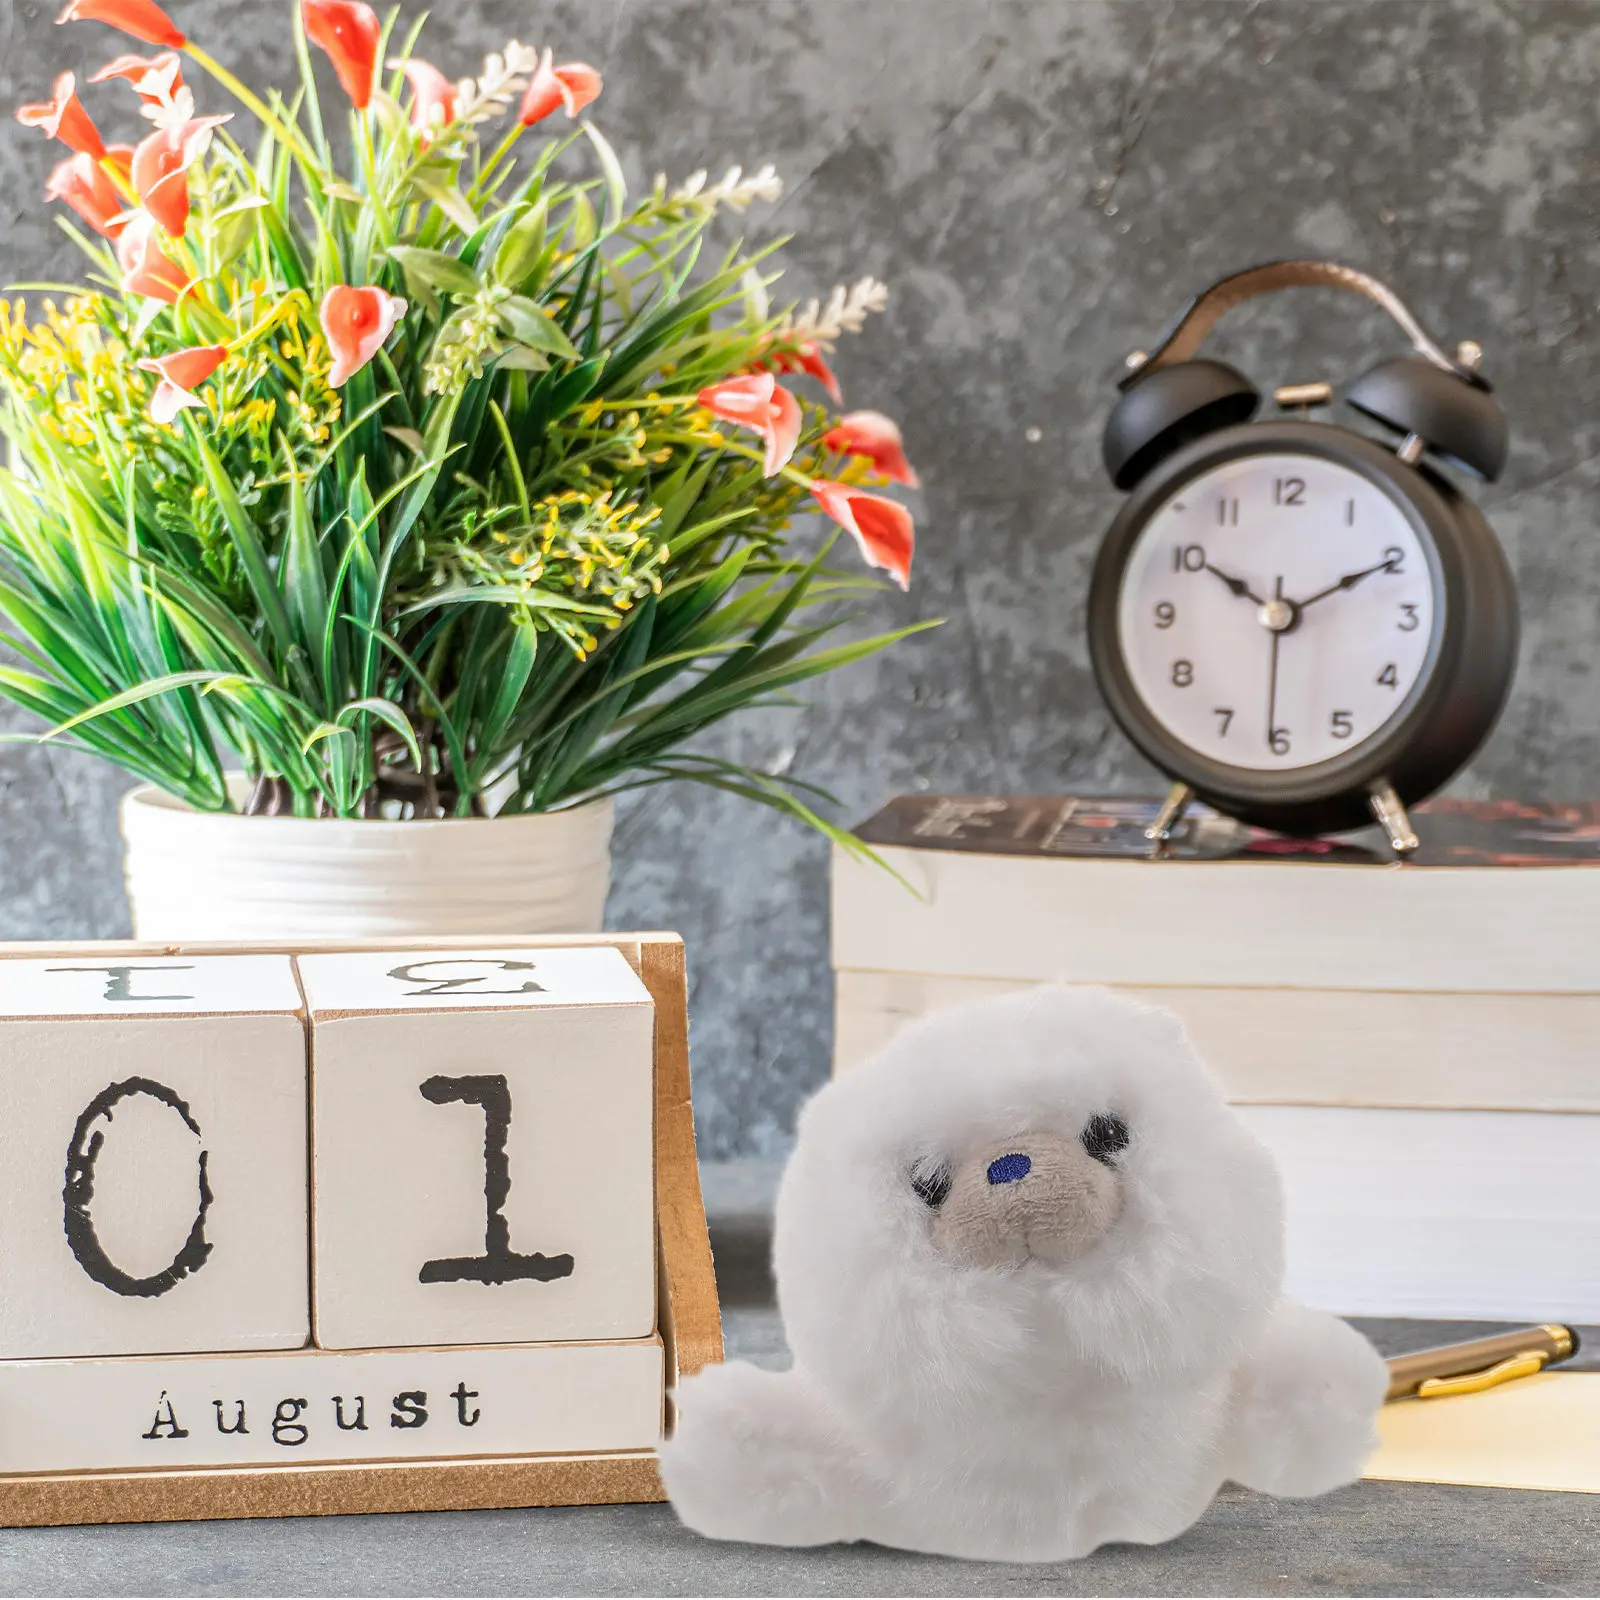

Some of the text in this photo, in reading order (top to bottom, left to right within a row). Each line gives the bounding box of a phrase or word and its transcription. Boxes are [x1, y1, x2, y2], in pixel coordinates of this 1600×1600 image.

[1275, 477, 1306, 506] 12
[1218, 497, 1239, 526] 11
[1346, 499, 1354, 527] 1
[1173, 543, 1206, 574] 10
[1382, 547, 1405, 575] 2
[1154, 602, 1176, 630] 9
[1397, 604, 1419, 632] 3
[1171, 659, 1194, 688] 8
[1376, 662, 1398, 690] 4
[1213, 708, 1235, 738] 7
[1330, 709, 1354, 738] 5
[1270, 727, 1291, 756] 6
[141, 1381, 482, 1447] August
